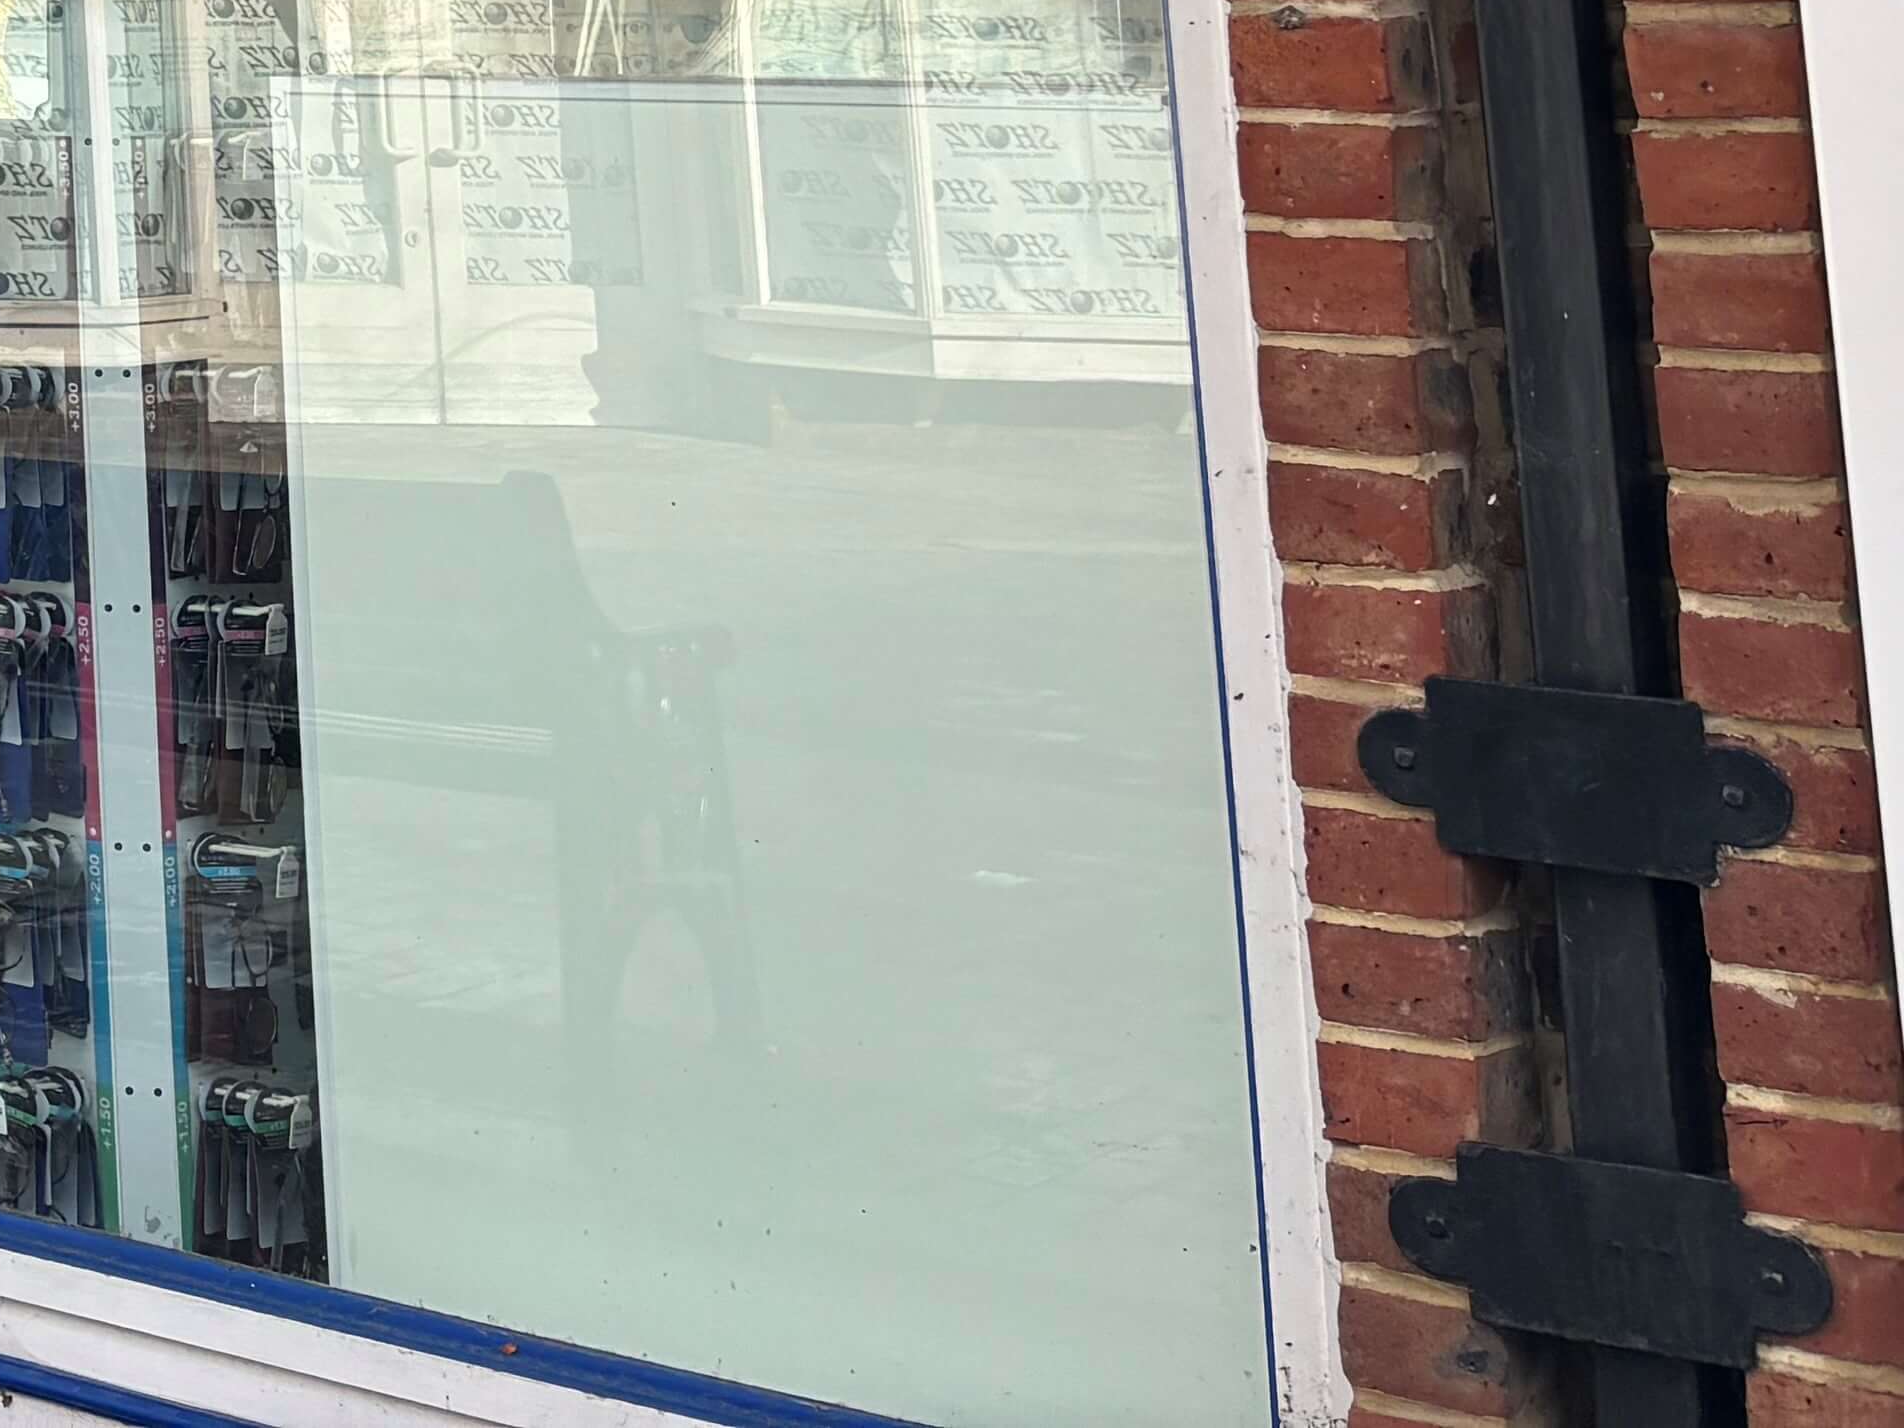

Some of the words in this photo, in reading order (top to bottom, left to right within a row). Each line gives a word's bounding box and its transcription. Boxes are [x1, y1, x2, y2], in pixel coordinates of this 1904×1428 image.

[68, 382, 80, 432] +3.00
[145, 383, 156, 433] +3.00
[78, 615, 91, 665] +2.50
[155, 616, 167, 666] +2.50
[90, 853, 102, 905] +2.00
[165, 855, 177, 907] +2.00
[99, 1096, 112, 1150] +1.50
[177, 1100, 189, 1154] +1.50
